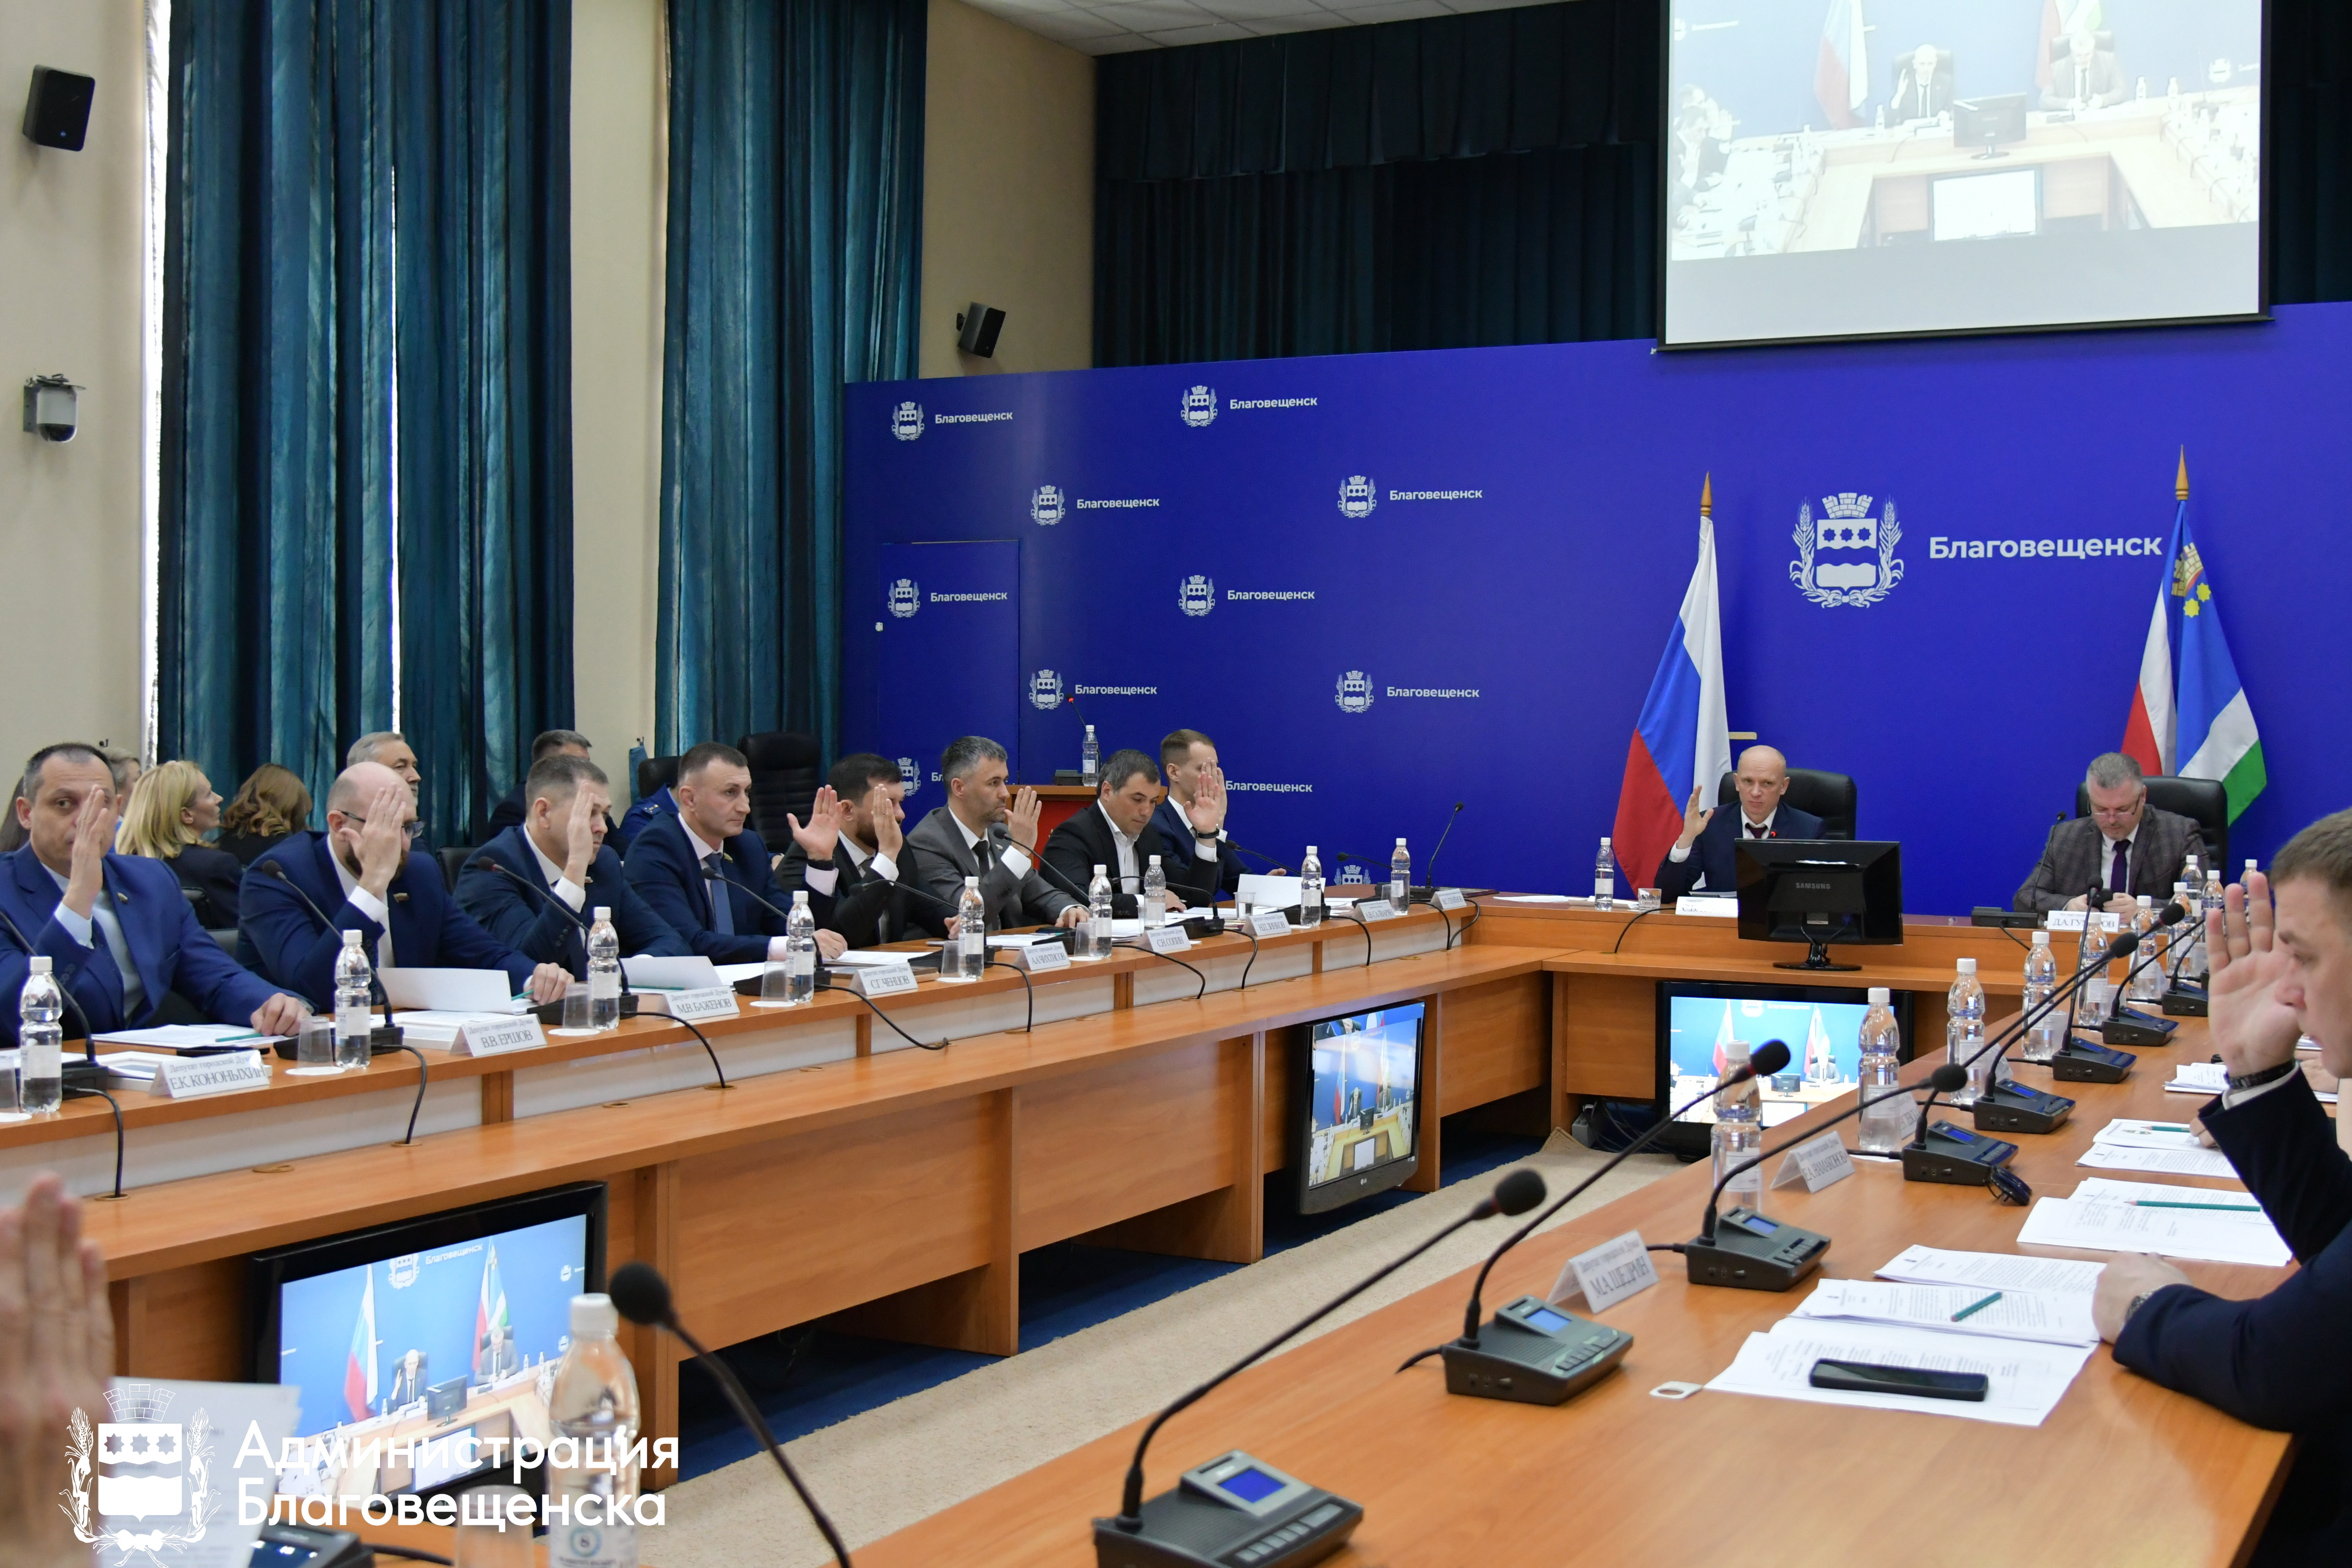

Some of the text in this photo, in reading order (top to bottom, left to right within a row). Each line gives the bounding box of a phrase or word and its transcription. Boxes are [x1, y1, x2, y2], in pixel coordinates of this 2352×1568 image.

[1230, 397, 1318, 409] Благовещенск
[935, 412, 1013, 424] Благовещенск
[1389, 490, 1483, 501] Благовещенск
[1077, 498, 1160, 509] Благовещенск
[1930, 536, 2162, 560] Благовещенск
[931, 592, 1007, 602] Благовещенск
[1228, 590, 1315, 601] Благовещенск
[1075, 684, 1157, 695] Благовещенск
[1387, 686, 1480, 698] Благовещенск
[1225, 780, 1313, 793] Благовещенск
[2053, 918, 2115, 928] Д.А. ГУОВ
[1166, 936, 1184, 946] СОПИН
[882, 975, 910, 987] ЧЕНЦОВ
[691, 990, 714, 999] городской
[693, 998, 732, 1011] БАЖЕНОВ
[468, 1019, 534, 1034] Депутат городской Думы
[481, 1030, 533, 1048] В.В. ЕРШОВ
[171, 1055, 253, 1073] Депутат городской Дум
[190, 1065, 266, 1087] КОНОНЫХИН
[425, 1243, 483, 1265] Благовещенск
[1608, 1256, 1650, 1289] ЩЕДРИН
